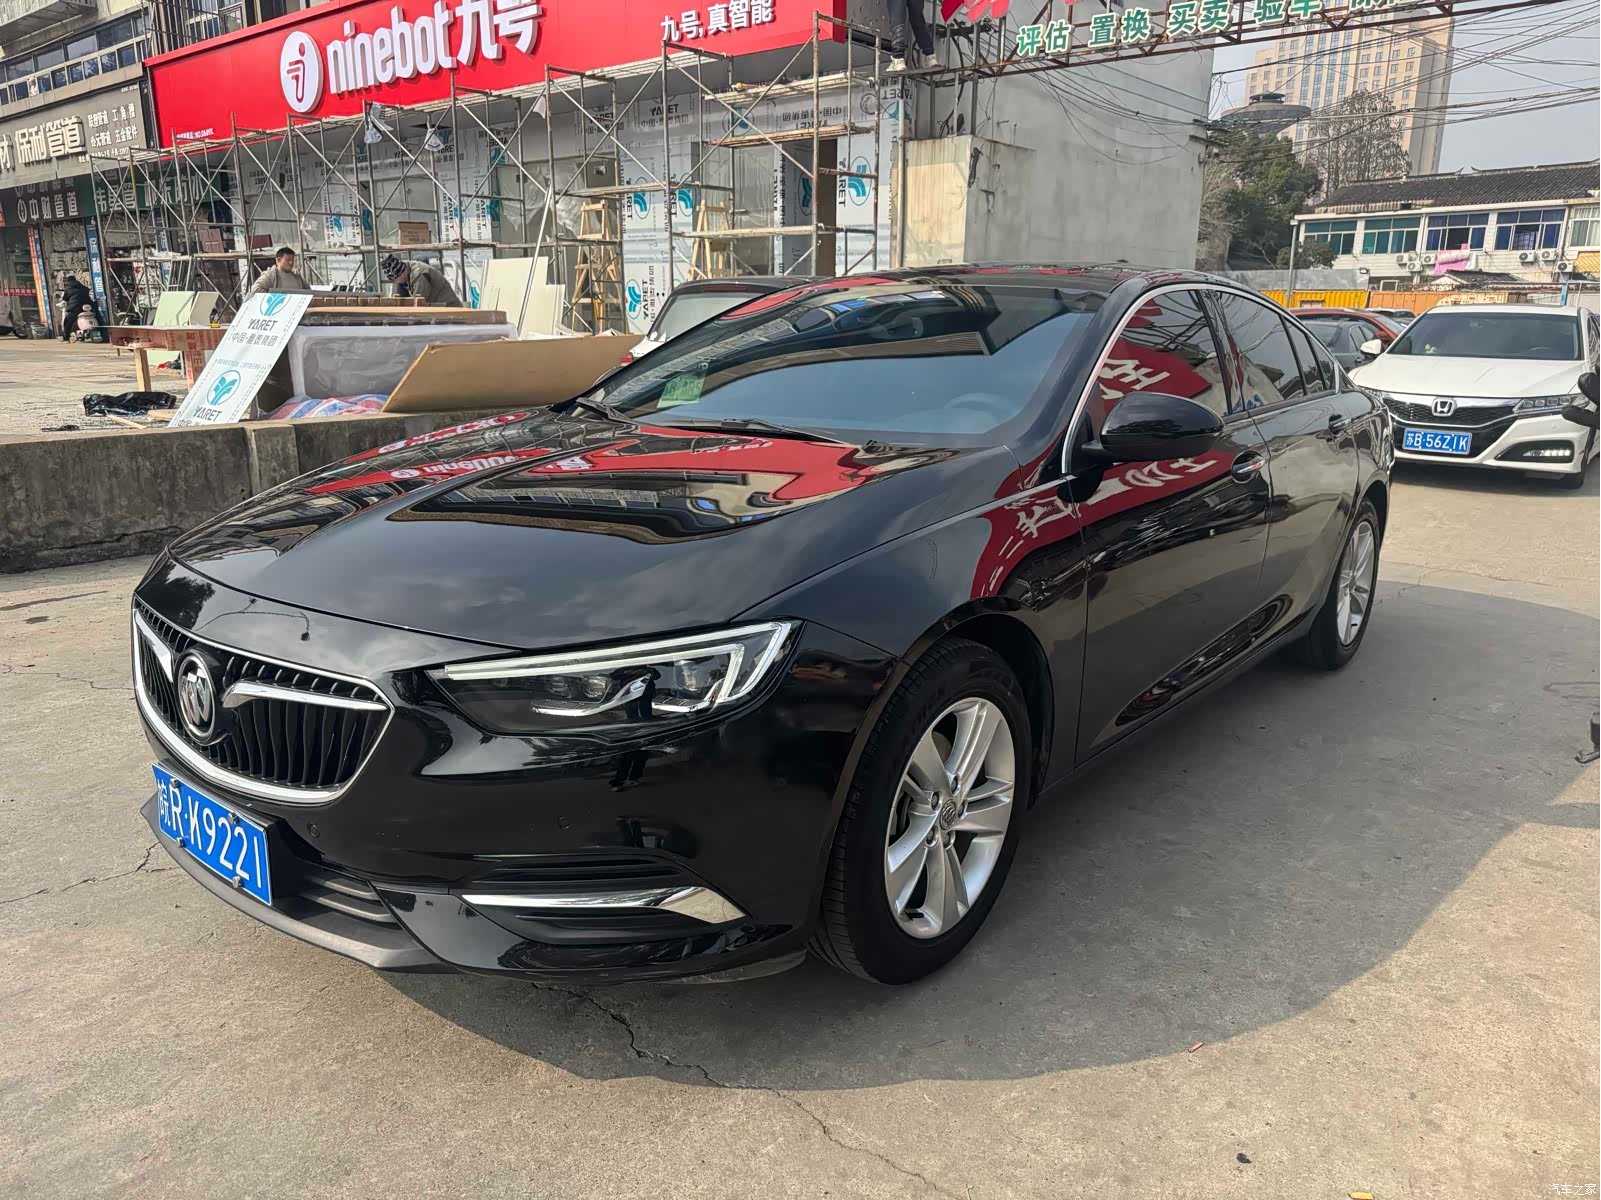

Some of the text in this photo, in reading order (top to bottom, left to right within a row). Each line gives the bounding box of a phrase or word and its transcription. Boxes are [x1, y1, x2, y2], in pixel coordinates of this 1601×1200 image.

[1016, 19, 1072, 56] 评估
[1088, 7, 1151, 48] 置换
[1166, 0, 1231, 35] 买卖
[327, 0, 543, 95] ninebot 九号
[649, 103, 679, 117] YAET
[248, 318, 278, 332] YARET
[193, 405, 223, 422] YARET
[157, 779, 262, 889] 皖R·K9221
